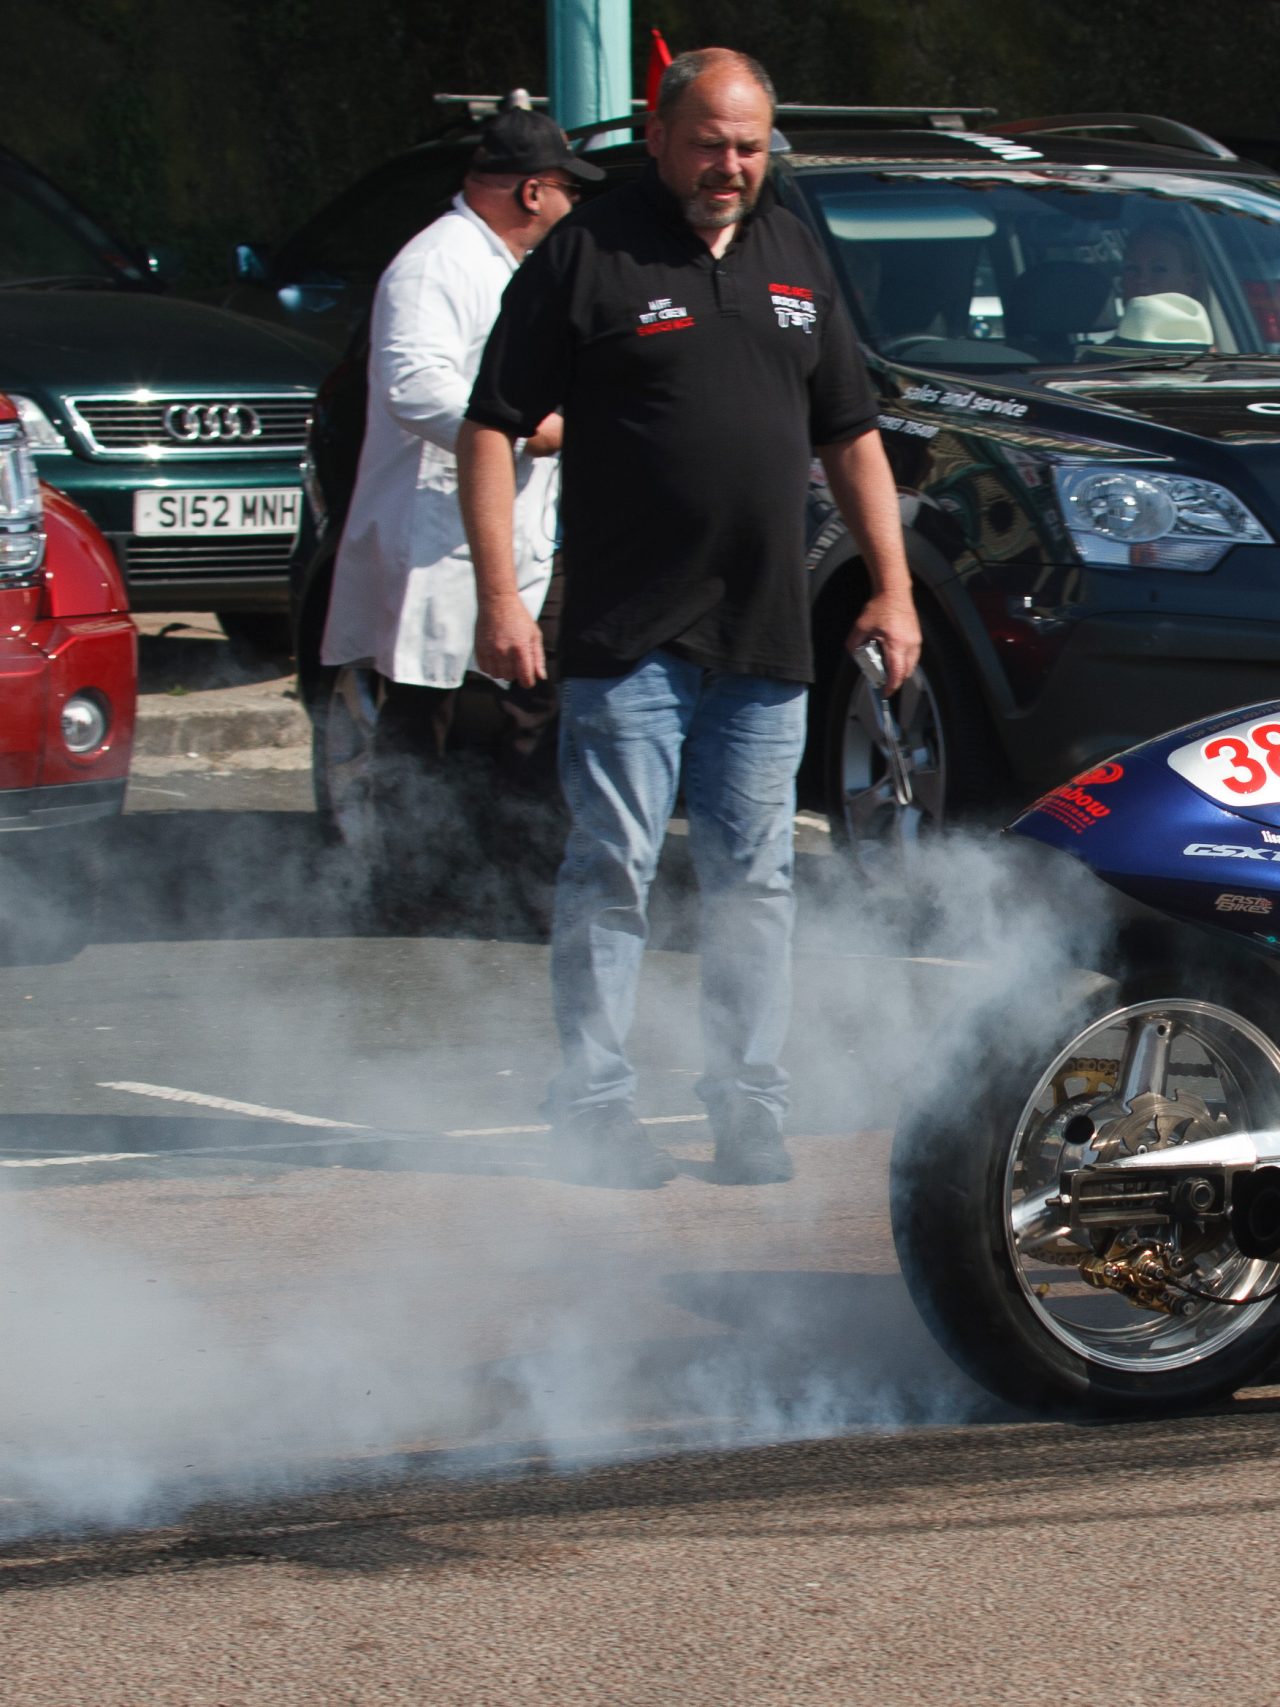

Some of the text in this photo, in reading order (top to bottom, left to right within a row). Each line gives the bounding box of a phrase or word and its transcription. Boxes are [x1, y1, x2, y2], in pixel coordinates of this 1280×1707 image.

[902, 384, 1029, 418] sales and service
[241, 495, 296, 526] MNH
